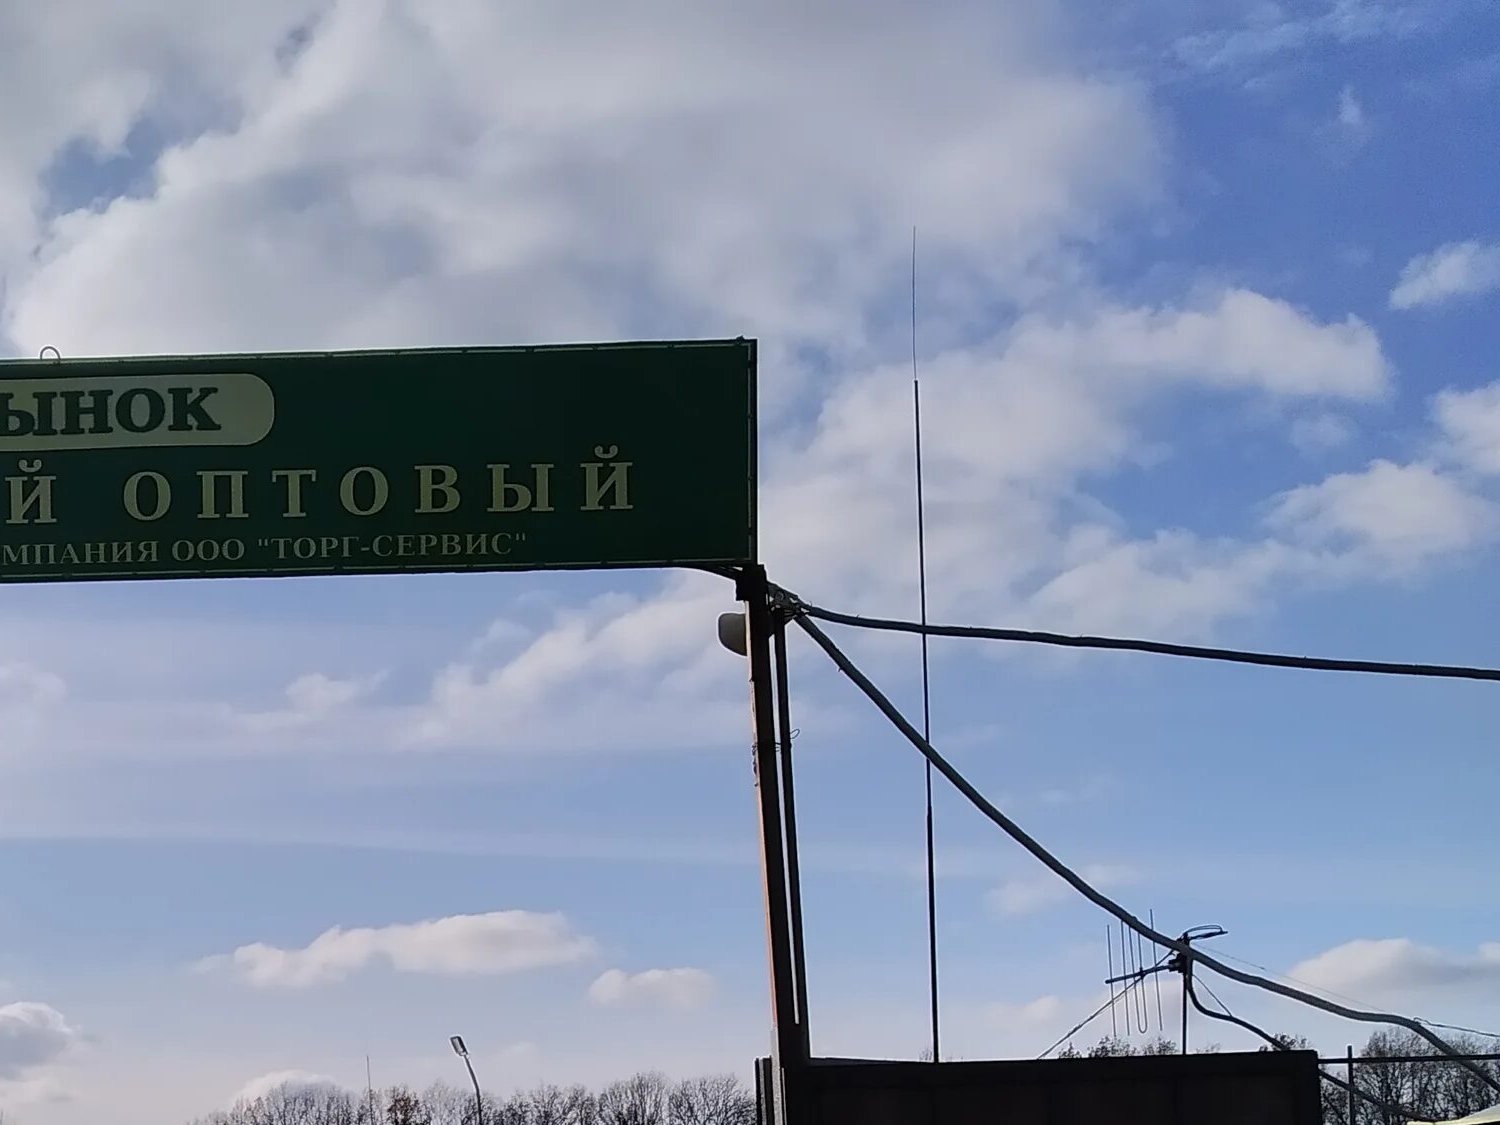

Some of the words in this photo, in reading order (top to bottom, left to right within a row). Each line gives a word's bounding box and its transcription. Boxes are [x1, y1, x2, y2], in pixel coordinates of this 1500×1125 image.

[123, 445, 634, 521] ОПТОВЫЙ
[171, 538, 245, 562] ООО
[257, 532, 527, 561] "ТОРГ-СЕРВИС"
